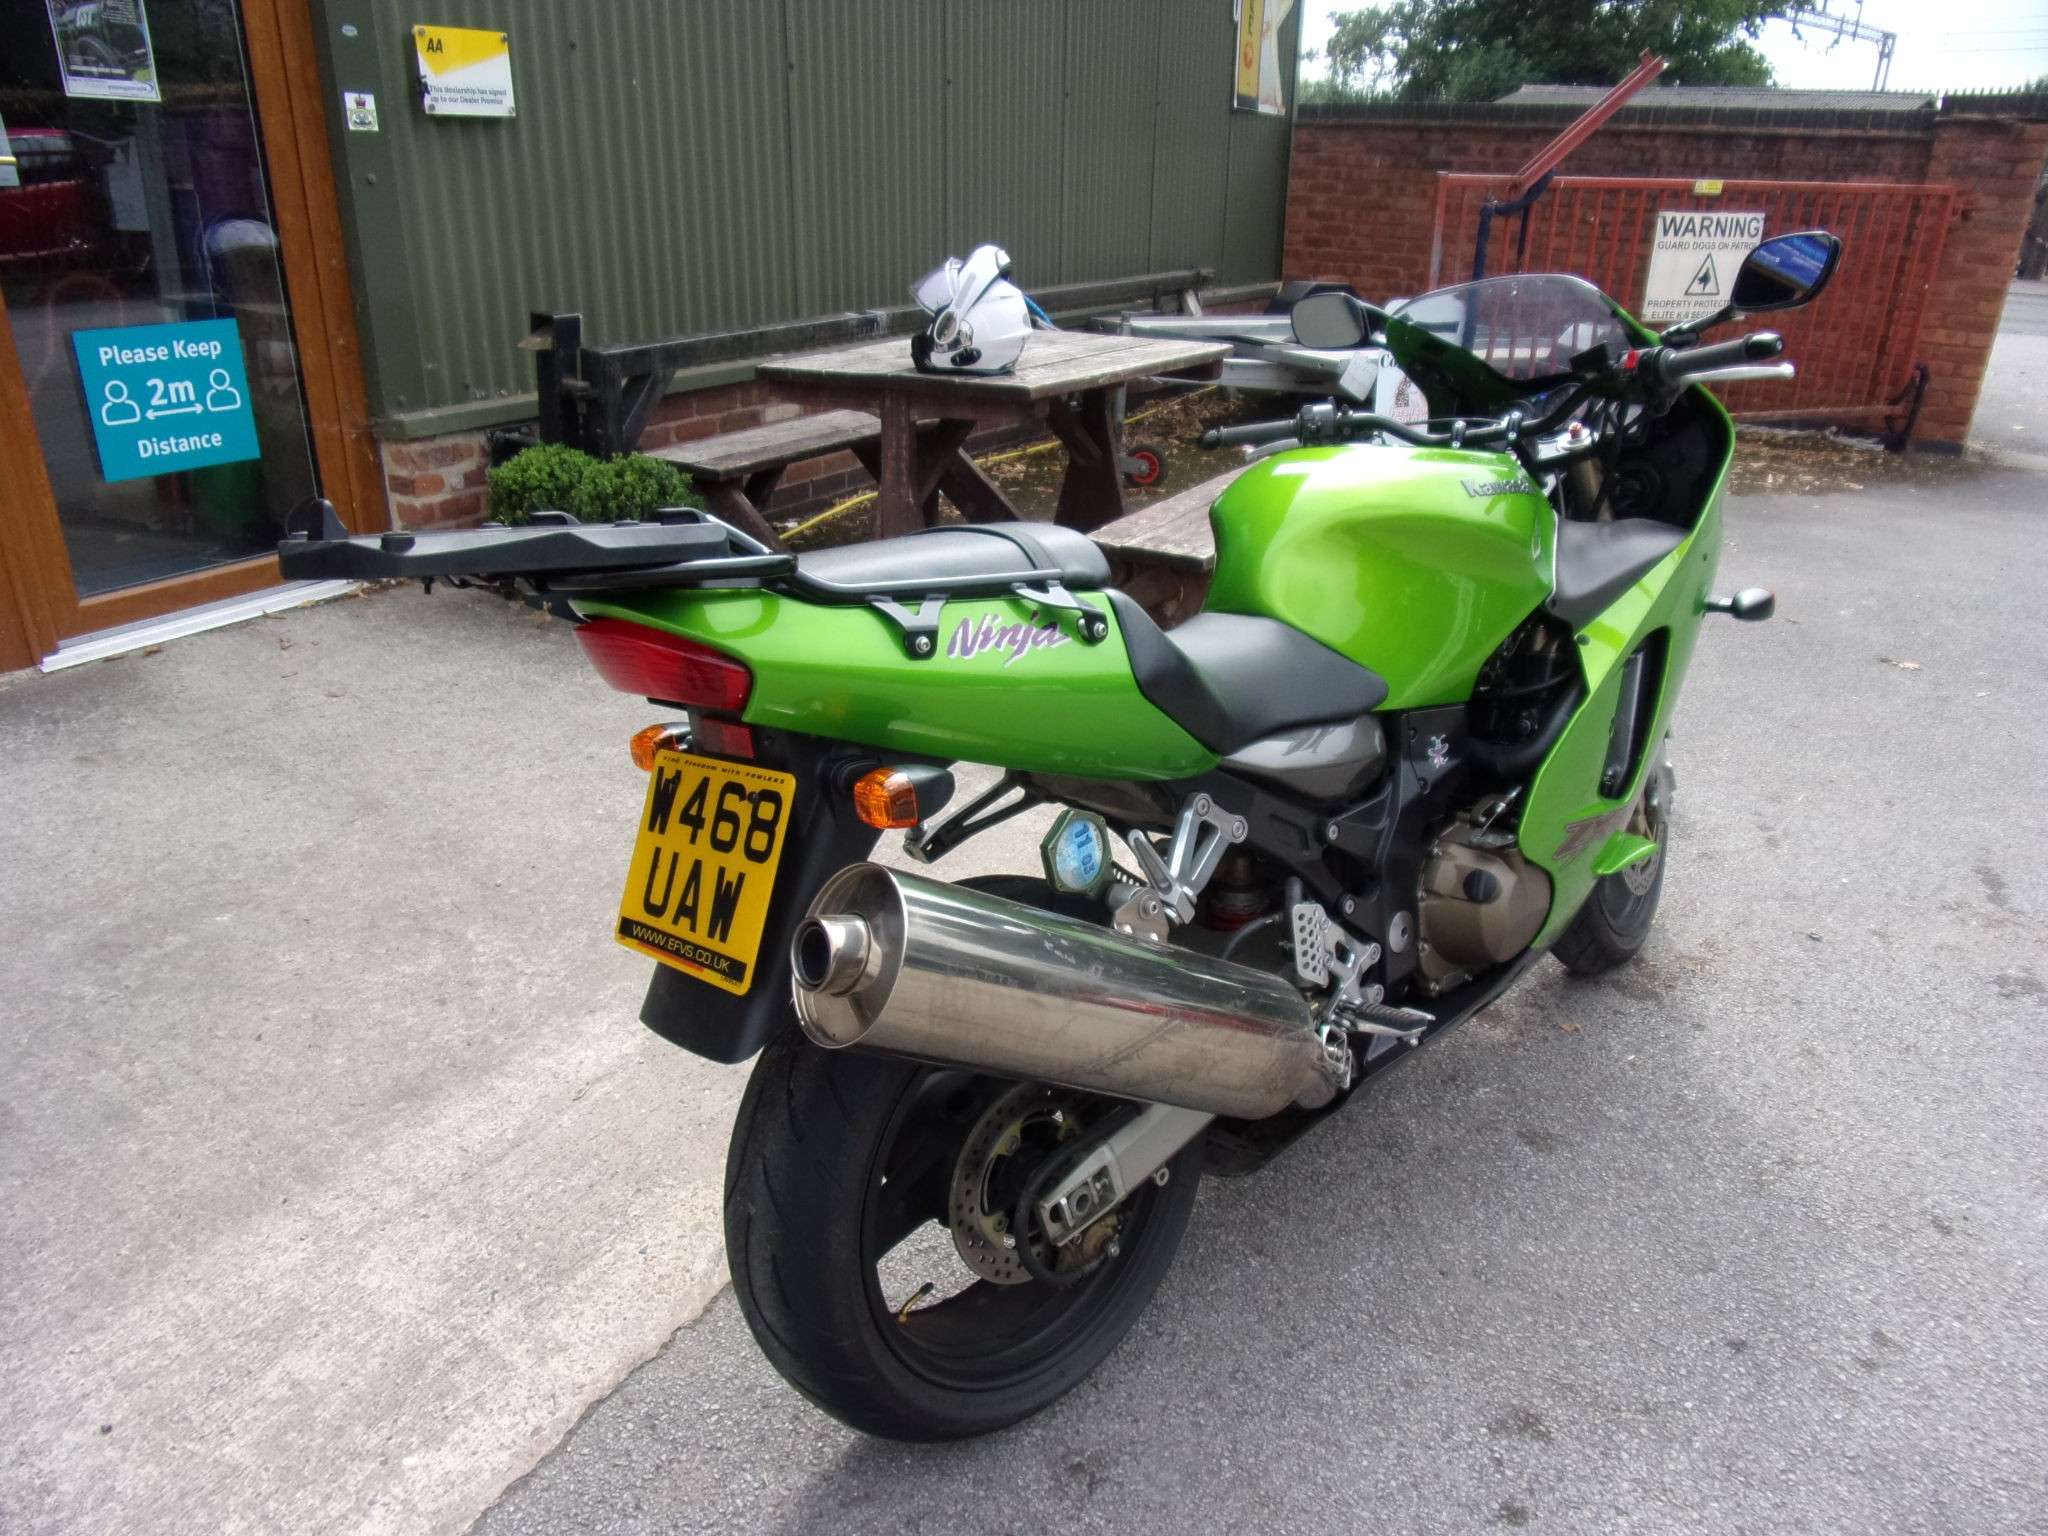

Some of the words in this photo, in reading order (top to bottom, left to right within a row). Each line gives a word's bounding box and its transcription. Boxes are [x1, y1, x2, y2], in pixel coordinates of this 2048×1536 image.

[426, 38, 443, 54] AA
[429, 86, 443, 94] This
[1659, 215, 1761, 238] WARNING
[1657, 240, 1691, 250] GUARD
[1692, 241, 1716, 250] DOGS
[1718, 242, 1728, 250] ON
[1729, 242, 1757, 250] PATRO
[1647, 299, 1692, 308] PROPERTY
[1651, 310, 1675, 319] ELITE
[98, 345, 169, 367] Please
[172, 339, 222, 360] Keep
[146, 378, 196, 406] 2m
[137, 432, 222, 459] Distance
[946, 610, 1072, 669] Ninja
[648, 766, 783, 864] W468
[643, 846, 746, 944] UAW
